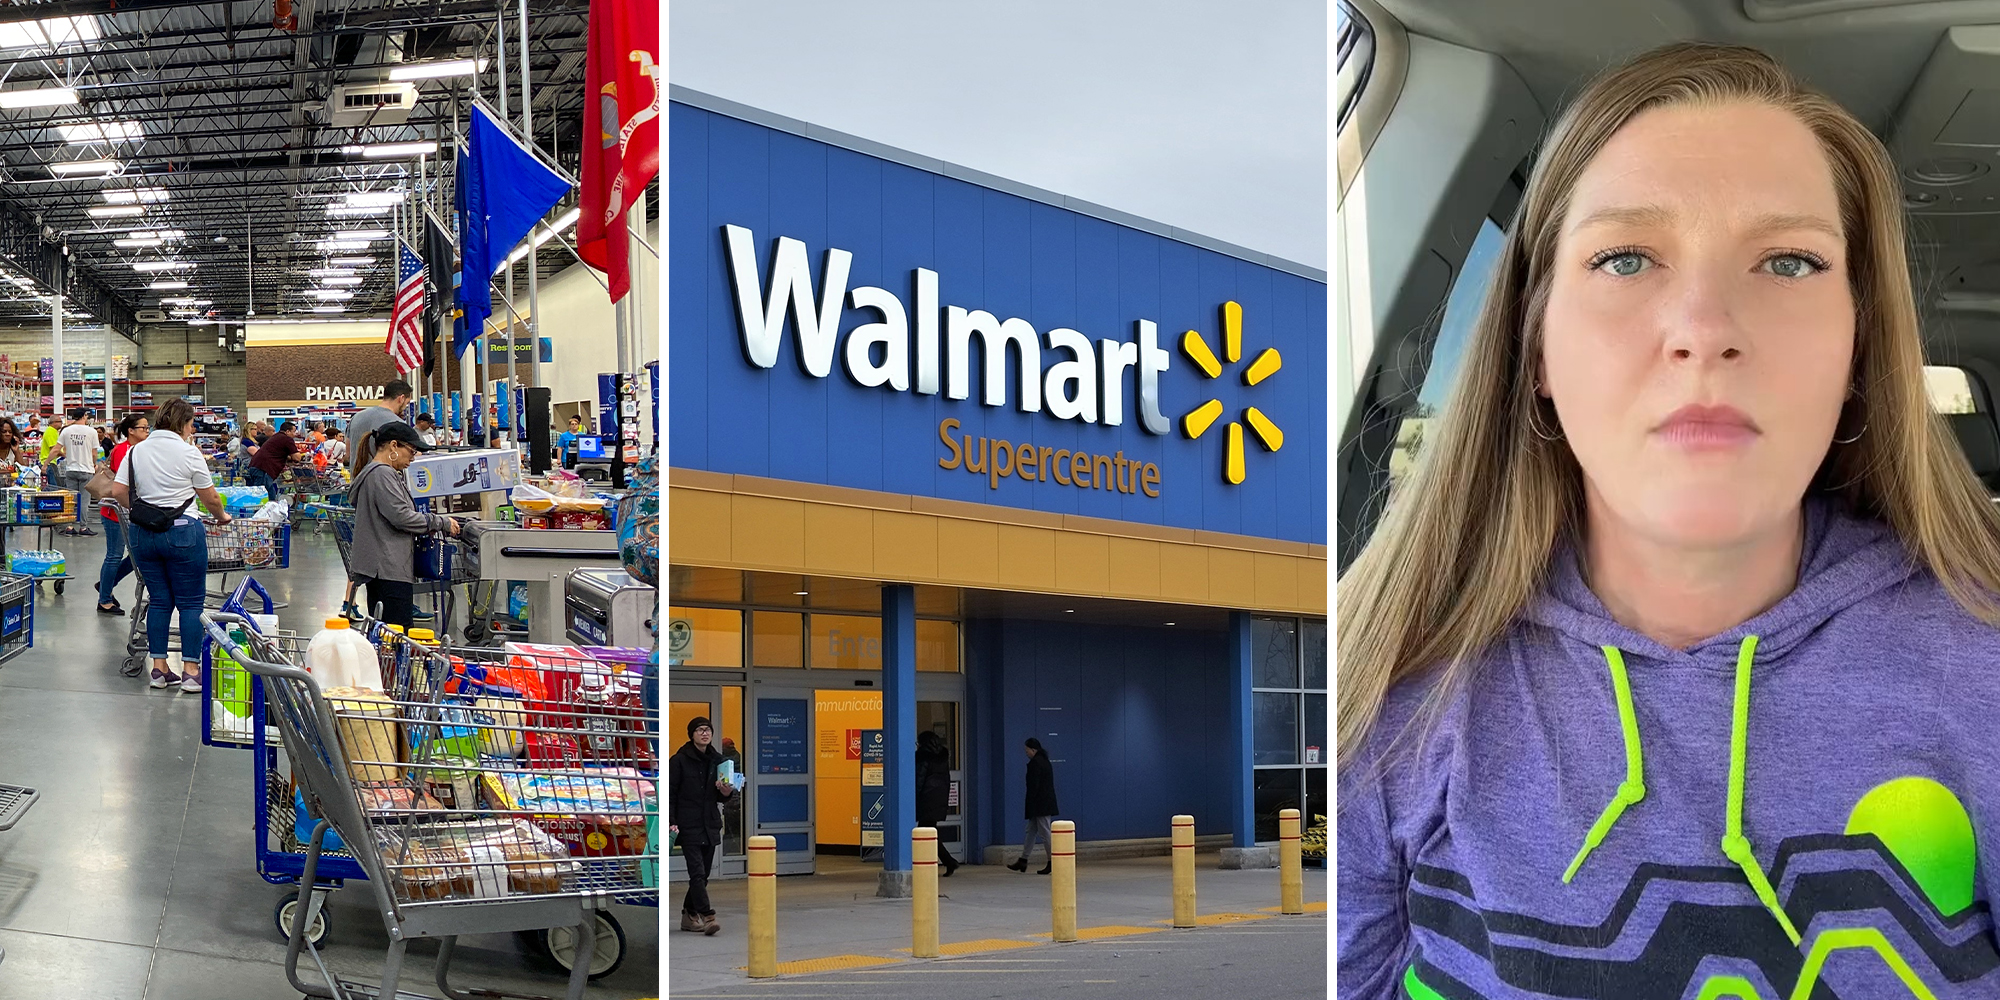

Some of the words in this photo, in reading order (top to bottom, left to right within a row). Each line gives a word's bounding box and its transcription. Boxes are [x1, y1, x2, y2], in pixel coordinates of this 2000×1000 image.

[719, 223, 1169, 435] Walmart
[306, 386, 385, 400] PHARMA
[938, 419, 1160, 498] Supercentre
[829, 629, 882, 658] Ente
[815, 696, 883, 711] mmunicatio
[536, 820, 586, 830] GIORNO
